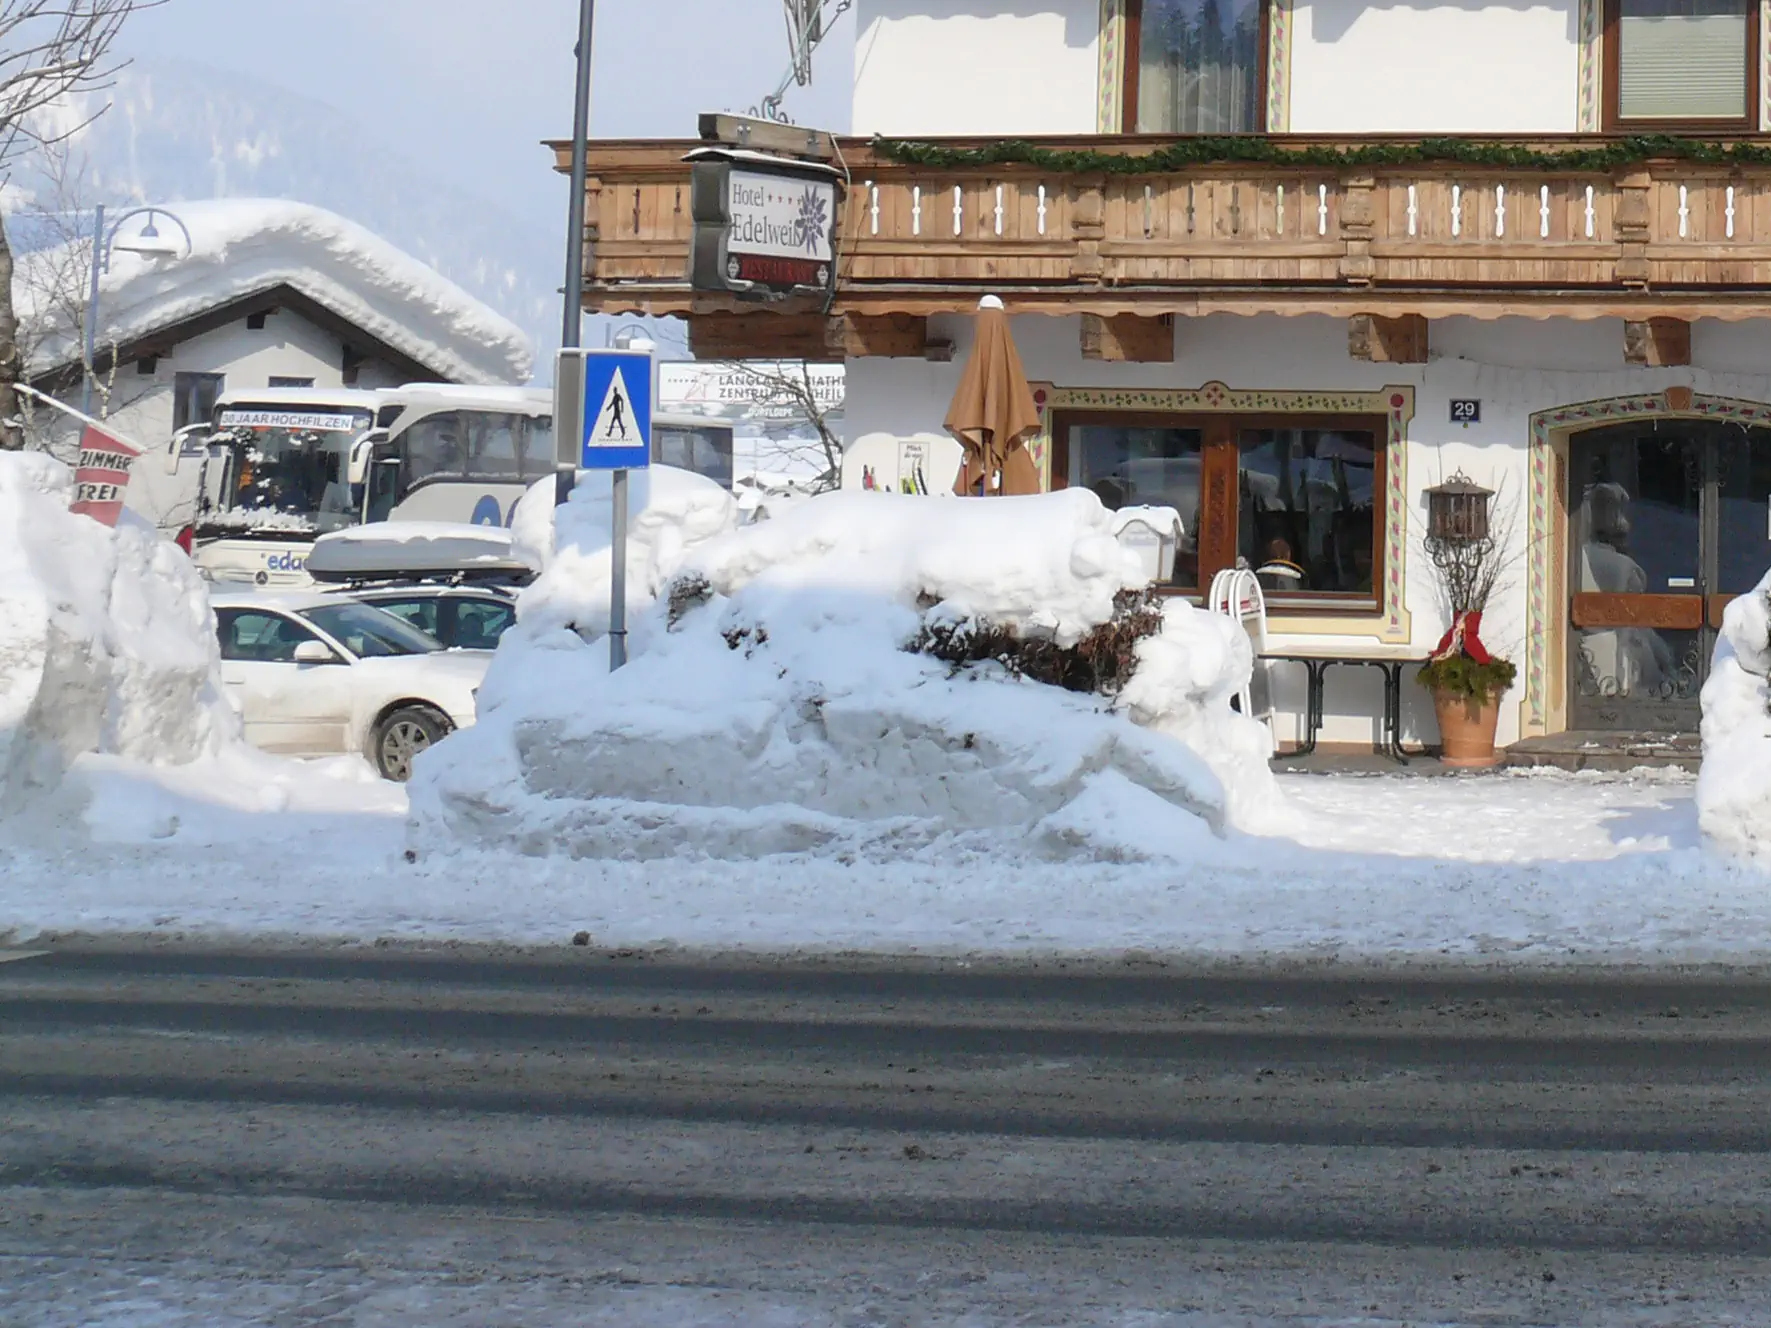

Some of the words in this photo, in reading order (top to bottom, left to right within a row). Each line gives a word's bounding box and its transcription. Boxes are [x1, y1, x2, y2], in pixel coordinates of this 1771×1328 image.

[732, 184, 764, 207] Hotel
[1455, 402, 1475, 416] 29
[222, 413, 235, 423] 30
[236, 414, 268, 424] JAAR
[270, 415, 350, 428] HOCHFILZEN
[80, 451, 132, 471] ZIMMER
[77, 483, 118, 500] FREI
[267, 549, 309, 571] eda
